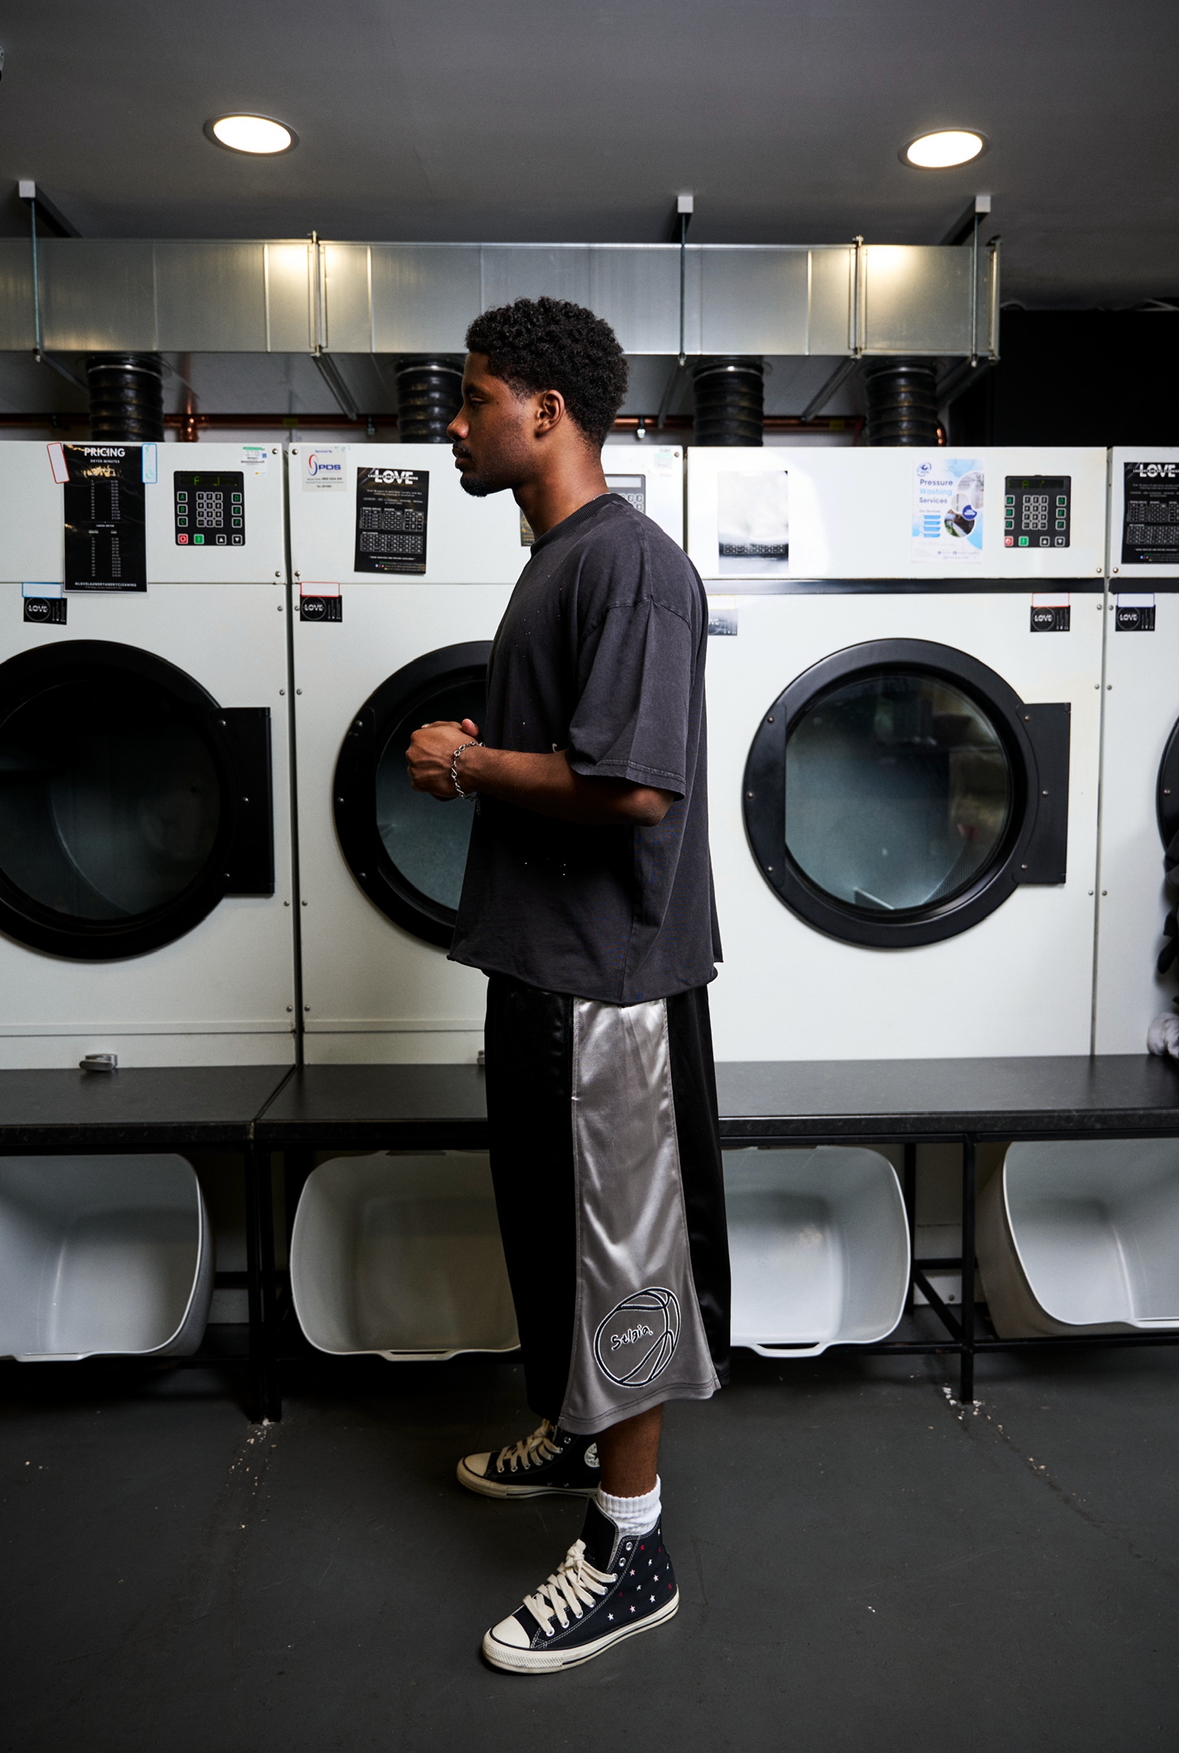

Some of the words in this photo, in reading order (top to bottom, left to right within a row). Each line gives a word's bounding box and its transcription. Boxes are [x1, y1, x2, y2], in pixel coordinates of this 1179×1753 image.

[84, 447, 126, 458] PRICING
[1139, 464, 1176, 478] LOVE
[374, 469, 414, 485] LOVE
[919, 478, 953, 486] Pressure
[919, 488, 953, 497] Washing
[28, 605, 47, 613] LOVE
[304, 604, 323, 612] LOVE
[1034, 614, 1052, 622] LOVE
